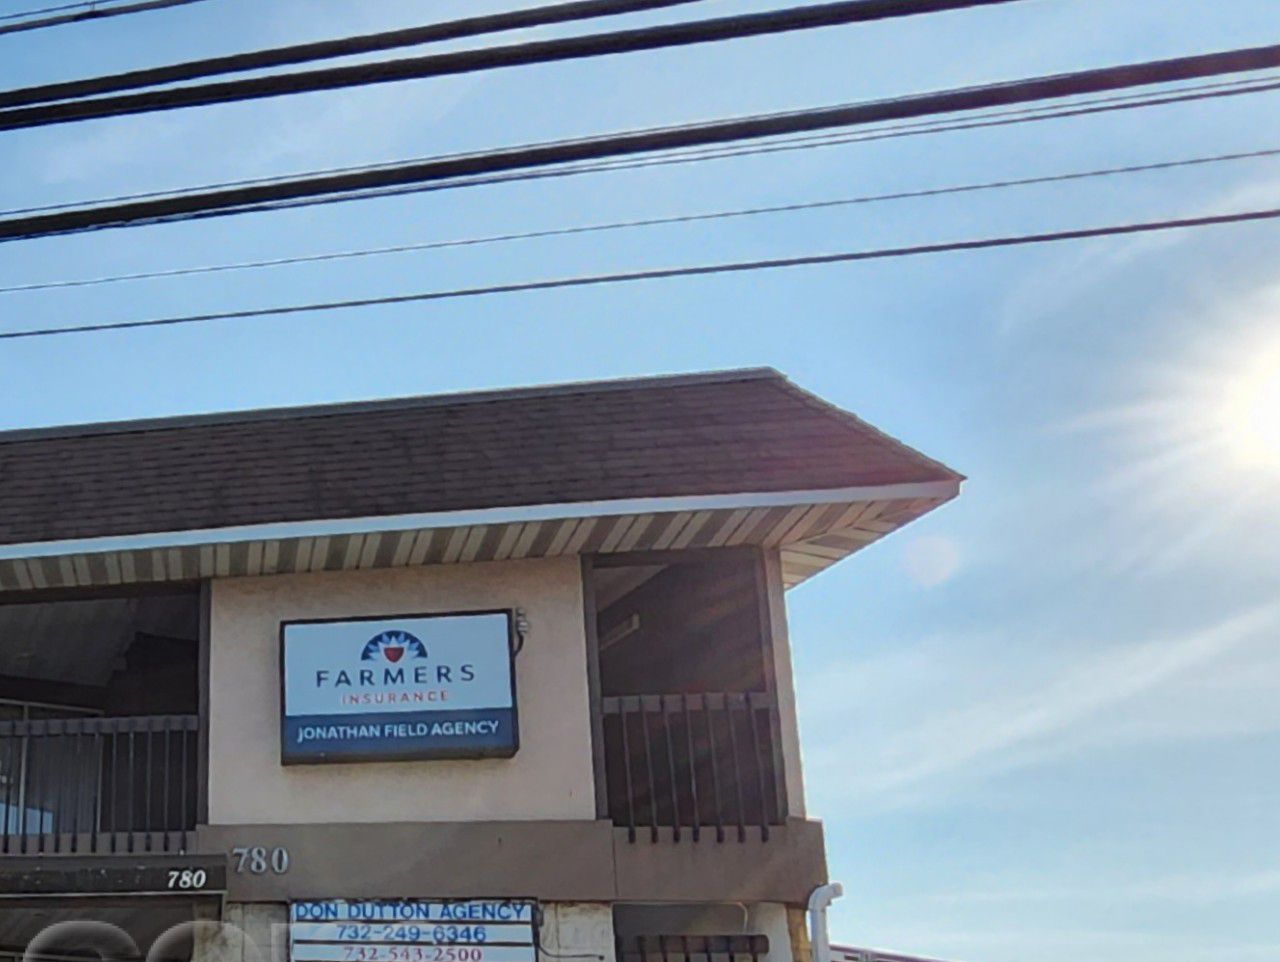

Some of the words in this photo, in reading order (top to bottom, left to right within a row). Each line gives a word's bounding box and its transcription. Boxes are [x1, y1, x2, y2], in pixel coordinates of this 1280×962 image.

[316, 664, 475, 688] FARMERS
[342, 690, 449, 705] INSURANCE
[297, 725, 381, 742] JONATHAN
[384, 723, 428, 737] FIELD
[430, 720, 499, 736] AGENCY
[231, 847, 290, 874] 780
[167, 869, 207, 888] 780
[294, 903, 338, 920] DON
[347, 903, 430, 920] DUTTON
[440, 903, 525, 920] AGENCY
[336, 925, 487, 943] 732-249-6346
[343, 947, 483, 962] 732-543-2500
